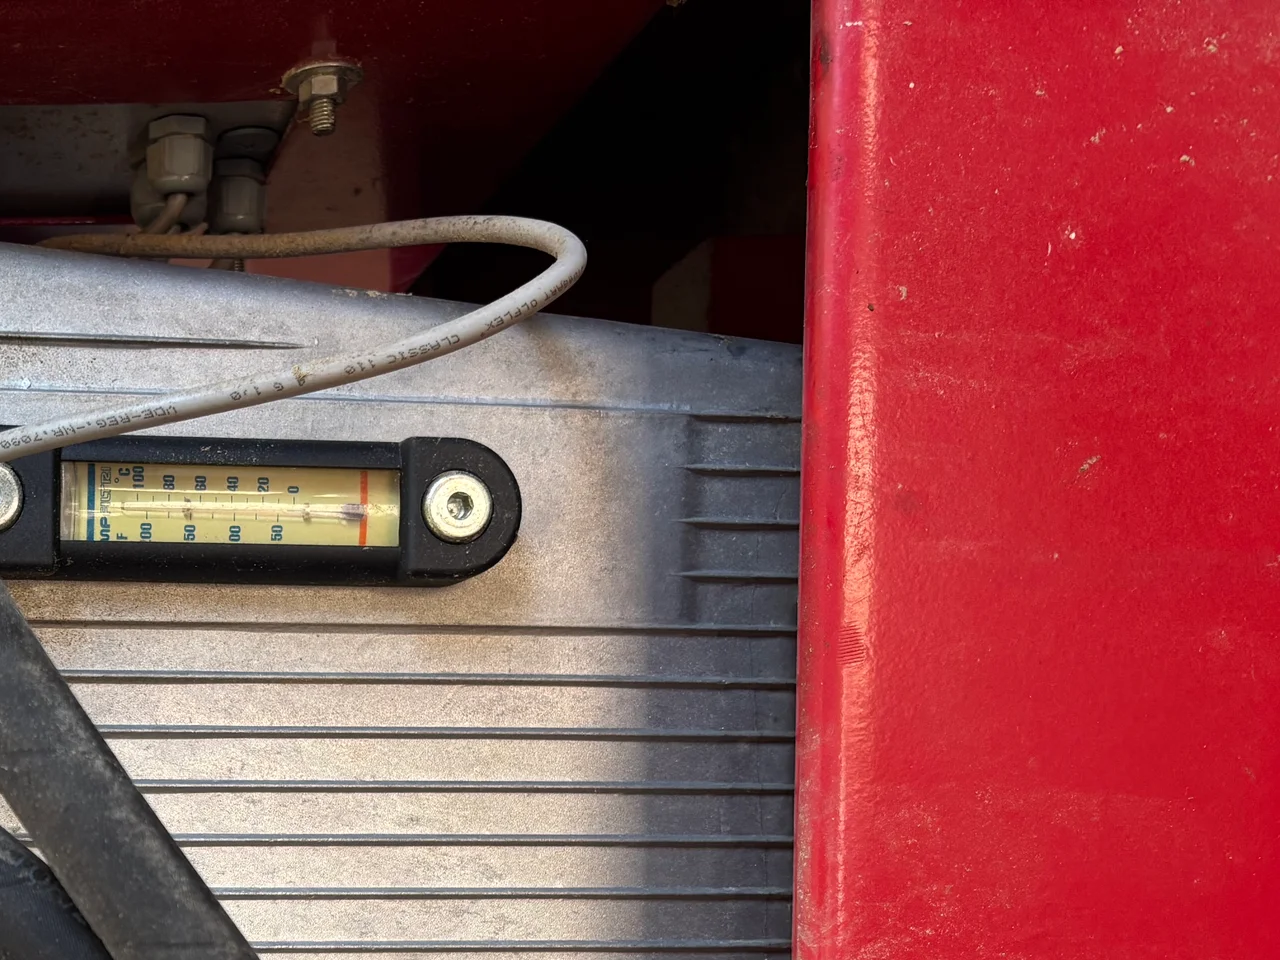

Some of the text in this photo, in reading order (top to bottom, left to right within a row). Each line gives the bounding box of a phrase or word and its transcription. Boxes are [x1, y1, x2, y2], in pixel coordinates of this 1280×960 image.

[132, 465, 145, 489] 100
[163, 474, 175, 490] 80
[194, 475, 207, 491] 60
[226, 476, 239, 492] 40
[257, 477, 269, 493] 20
[287, 485, 300, 494] 0
[140, 522, 152, 541] 00
